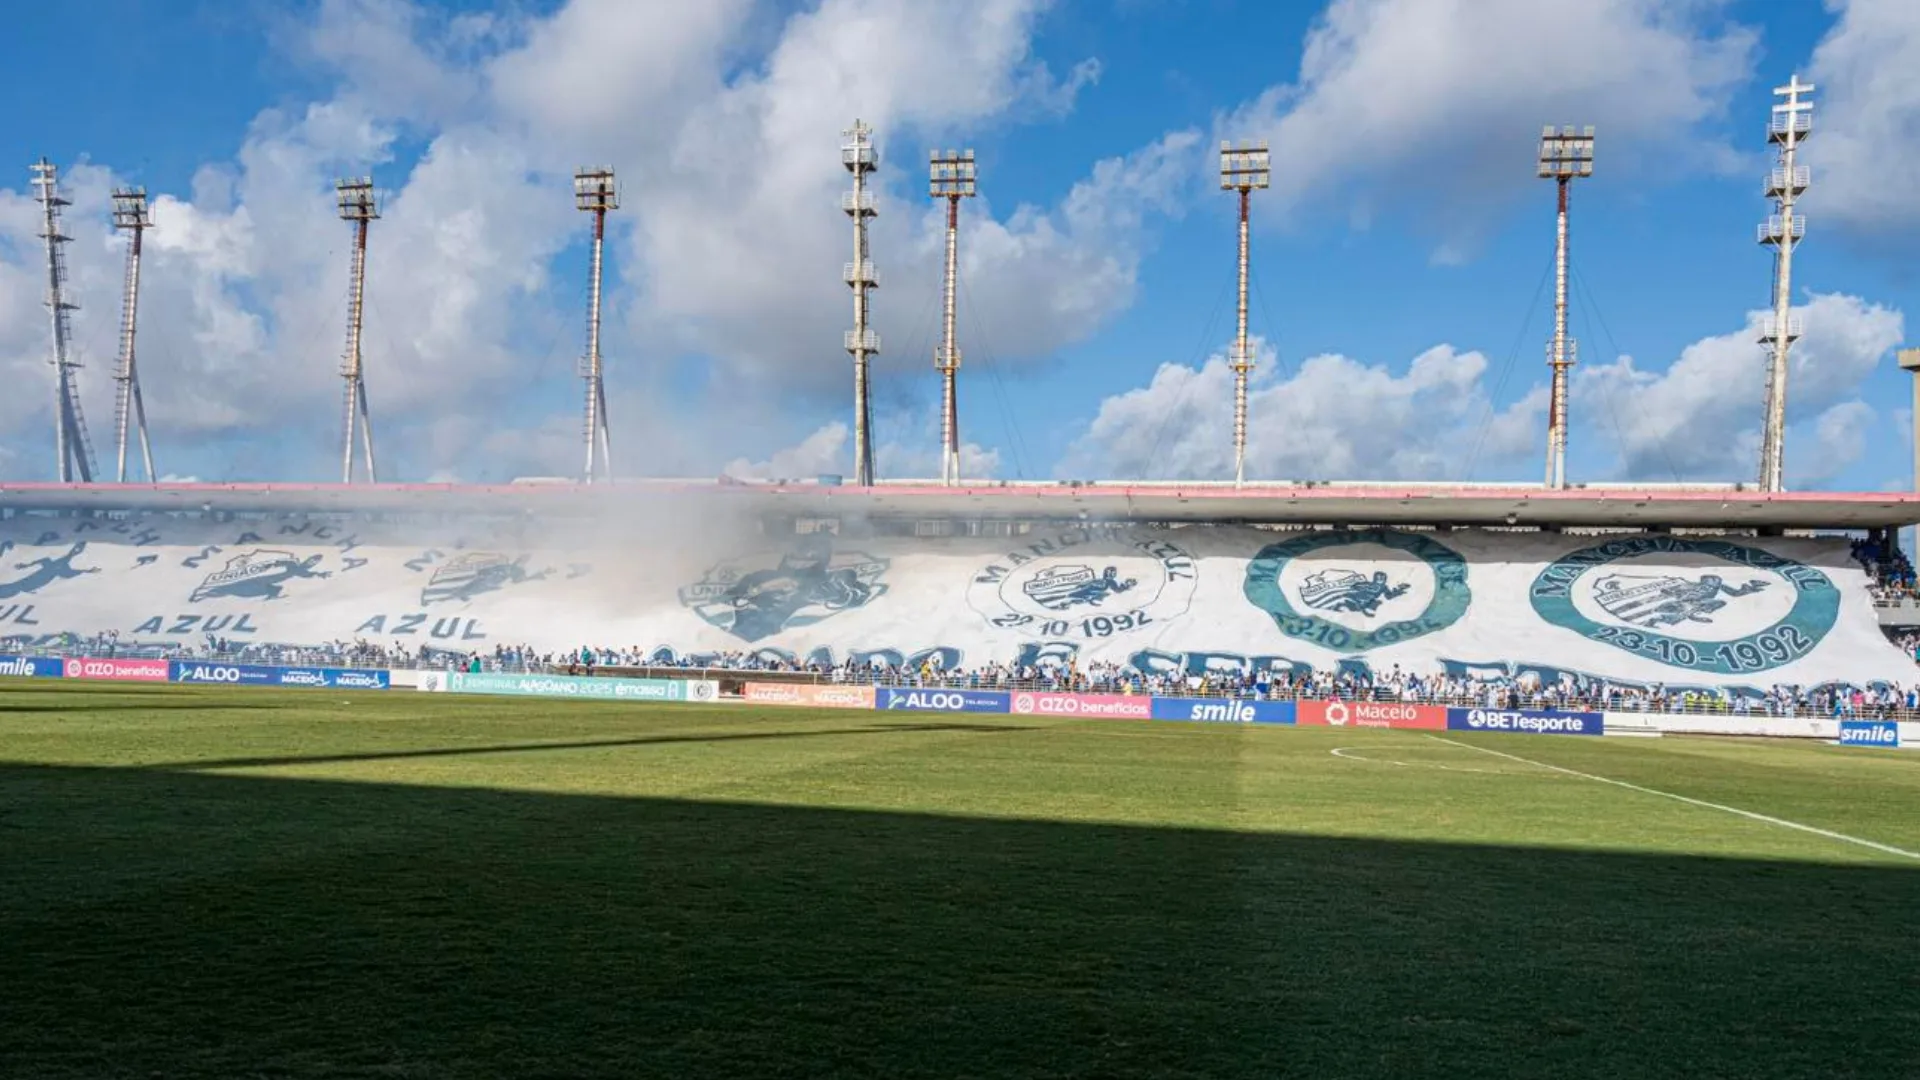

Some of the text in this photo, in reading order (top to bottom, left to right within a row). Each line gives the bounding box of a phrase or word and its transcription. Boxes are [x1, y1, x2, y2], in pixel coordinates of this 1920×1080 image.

[133, 613, 258, 634] AZUL
[354, 614, 488, 641] AZUL
[1080, 608, 1153, 638] 1992
[1592, 625, 1811, 672] 23-10-1992
[0, 657, 35, 676] mile
[84, 663, 115, 676] azo
[192, 666, 240, 682] ALOO
[905, 691, 964, 709] ALOO
[1039, 697, 1078, 712] azo
[1191, 701, 1256, 722] smile
[1355, 705, 1417, 721] Maceió
[1486, 712, 1584, 733] BETesporte
[1841, 725, 1895, 742] smile
